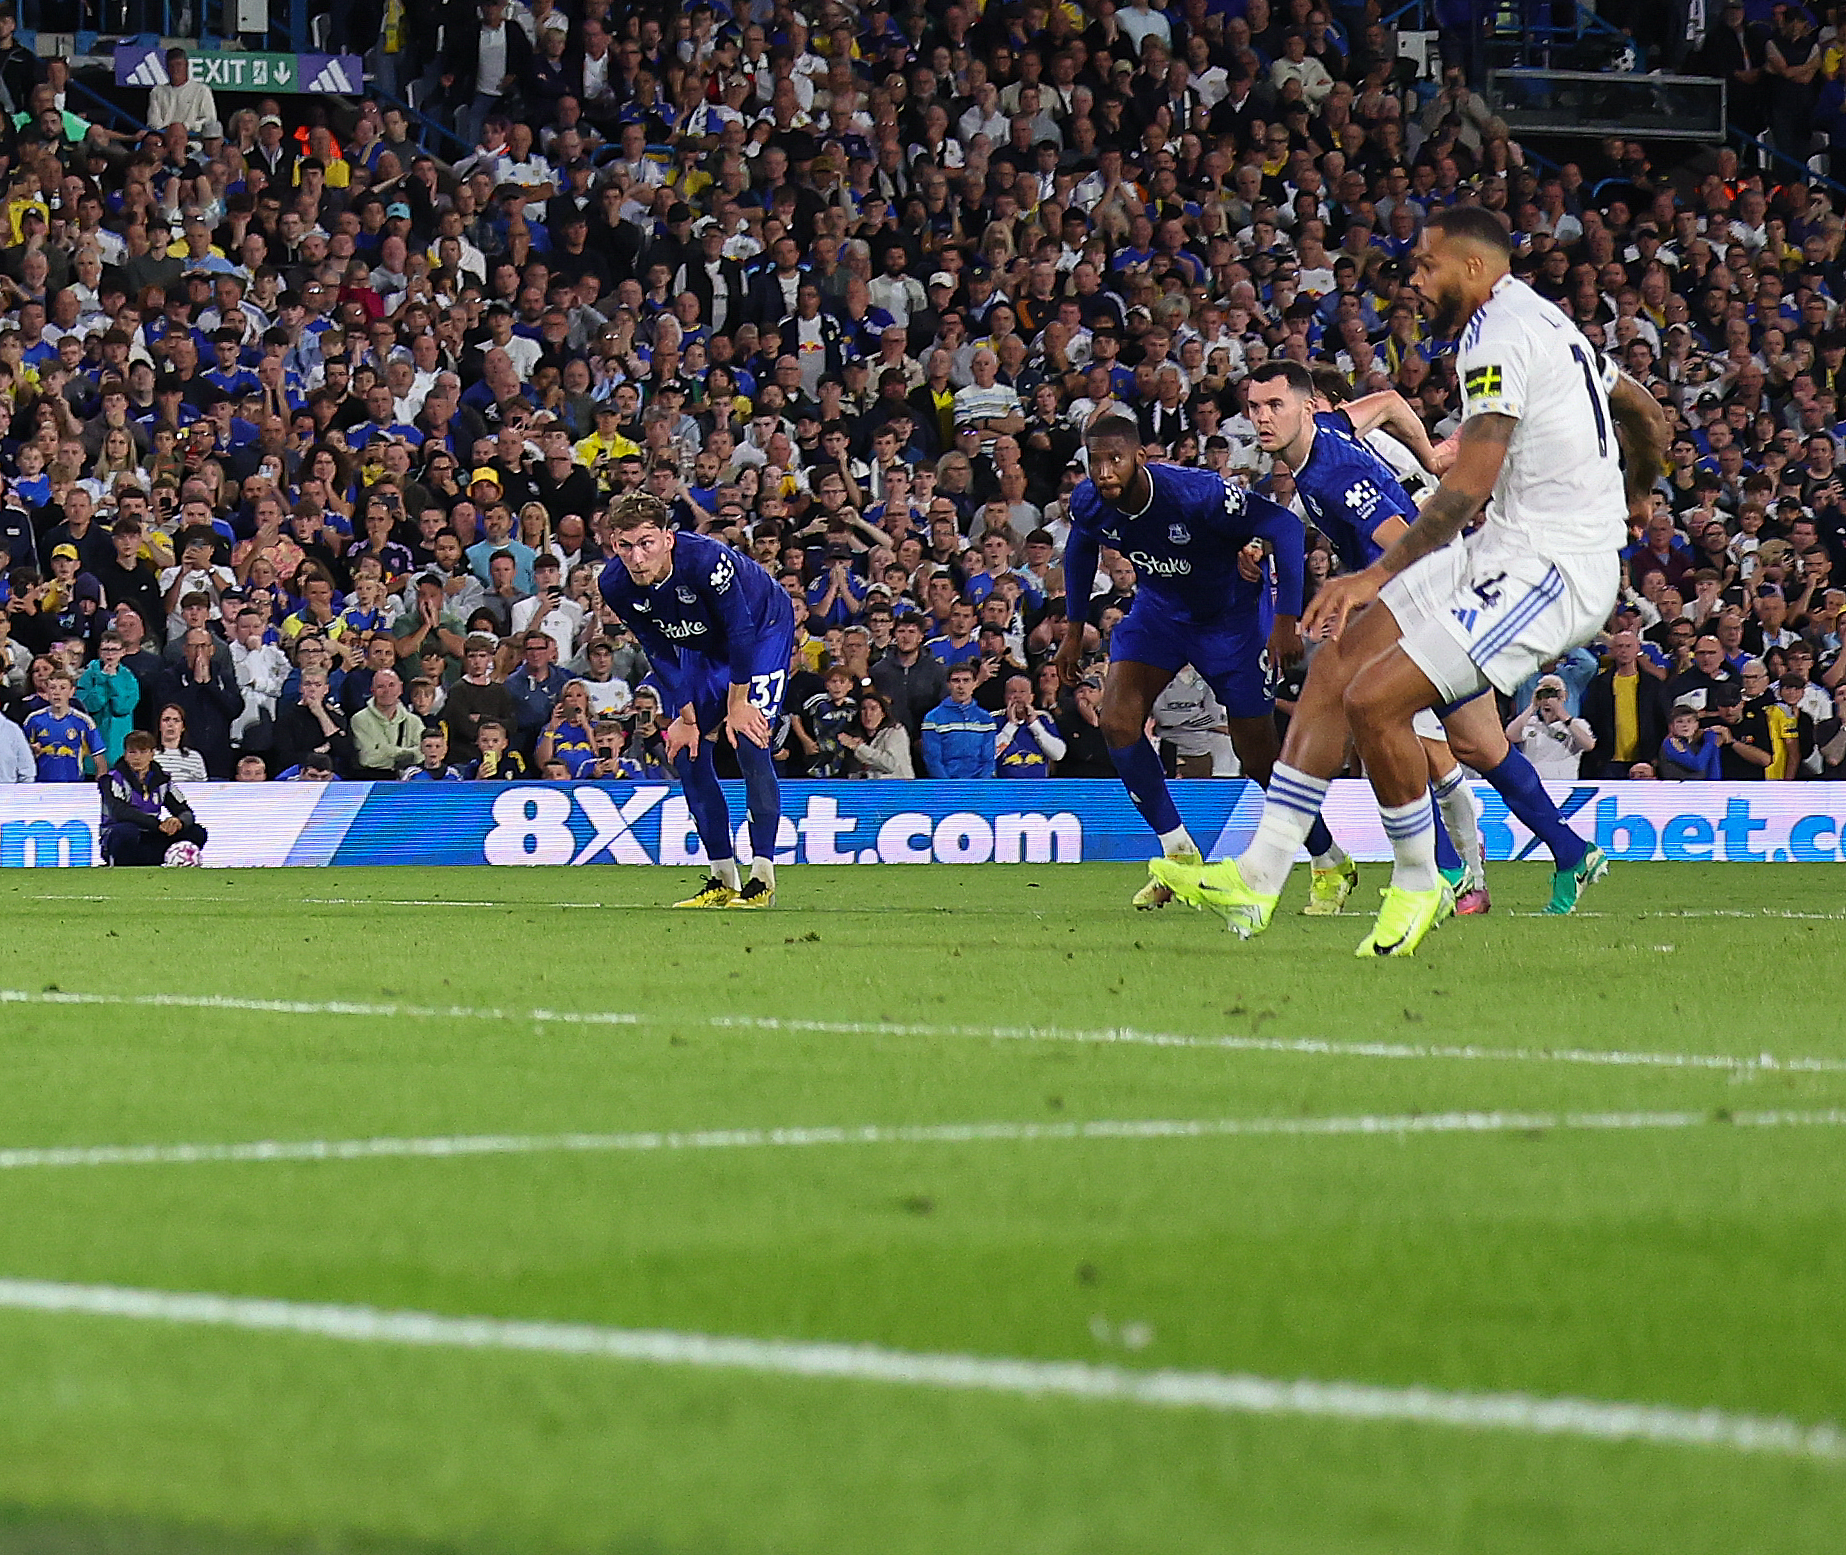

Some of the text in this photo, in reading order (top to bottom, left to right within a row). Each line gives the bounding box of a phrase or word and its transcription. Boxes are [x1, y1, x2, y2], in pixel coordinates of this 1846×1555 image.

[187, 57, 247, 85] EXIT
[1129, 550, 1192, 576] Stake
[749, 668, 785, 709] 37
